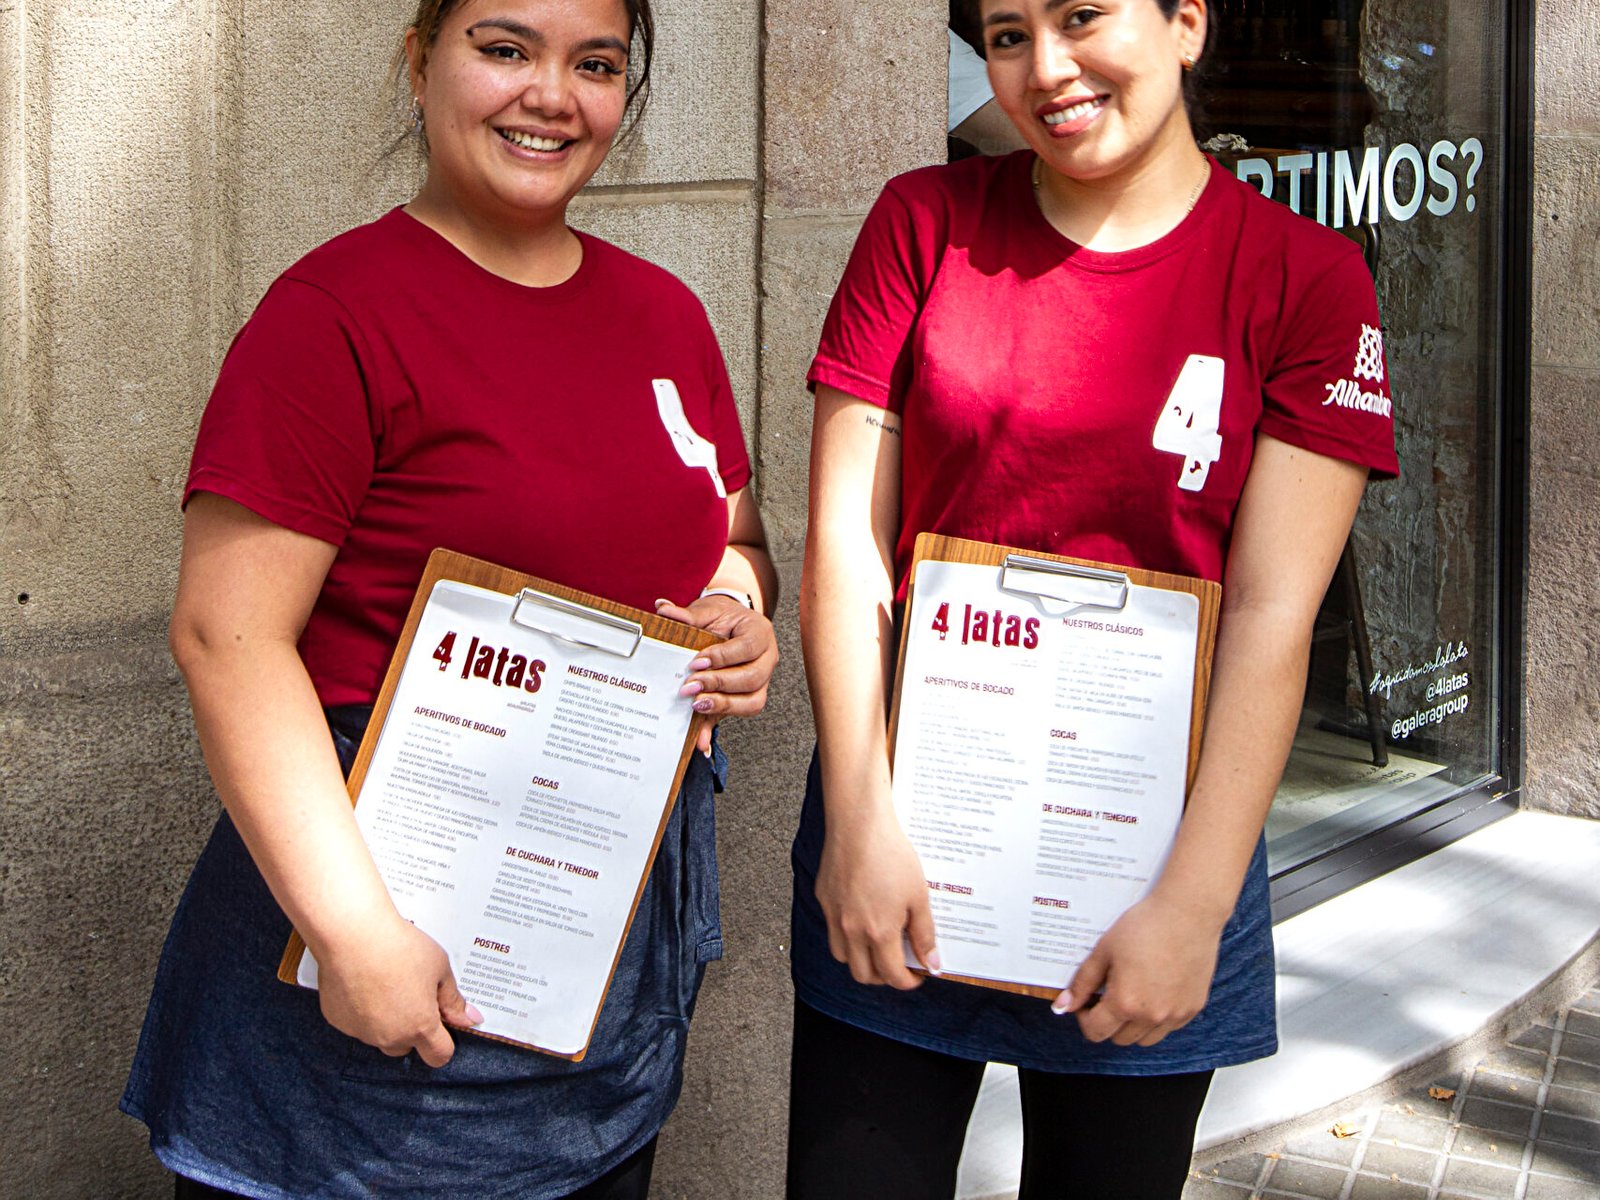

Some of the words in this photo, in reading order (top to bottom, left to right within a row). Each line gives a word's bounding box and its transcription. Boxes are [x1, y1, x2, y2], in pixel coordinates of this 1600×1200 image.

[1152, 354, 1226, 492] 4
[931, 602, 950, 640] 4
[961, 604, 1040, 650] latas
[1063, 618, 1102, 630] NUESTROS
[1106, 623, 1143, 635] CLÁSICOS
[432, 631, 457, 672] 4
[461, 636, 547, 694] latas
[568, 665, 608, 683] NUESTROS
[610, 677, 646, 693] CLÁSICOS
[924, 677, 968, 689] APERITIVOS
[971, 682, 979, 690] DE
[983, 683, 1013, 694] BOCADO
[1426, 672, 1469, 703] @4latas
[415, 707, 460, 725] APERITIVOS
[462, 719, 471, 728] DE
[474, 722, 506, 737] BOCADO
[1391, 698, 1469, 739] @galeragroup
[1050, 729, 1076, 739] COCAS
[532, 777, 559, 789] COCAS
[1043, 804, 1052, 812] DE
[1055, 805, 1091, 817] CUCHARA
[1102, 812, 1136, 823] TENEDOR
[506, 847, 519, 857] DE
[518, 850, 555, 866] CUCHARA
[554, 860, 563, 868] Y
[561, 862, 598, 879] TENEDOR
[1033, 897, 1068, 907] POSTRES
[474, 937, 510, 953] POSTRES
